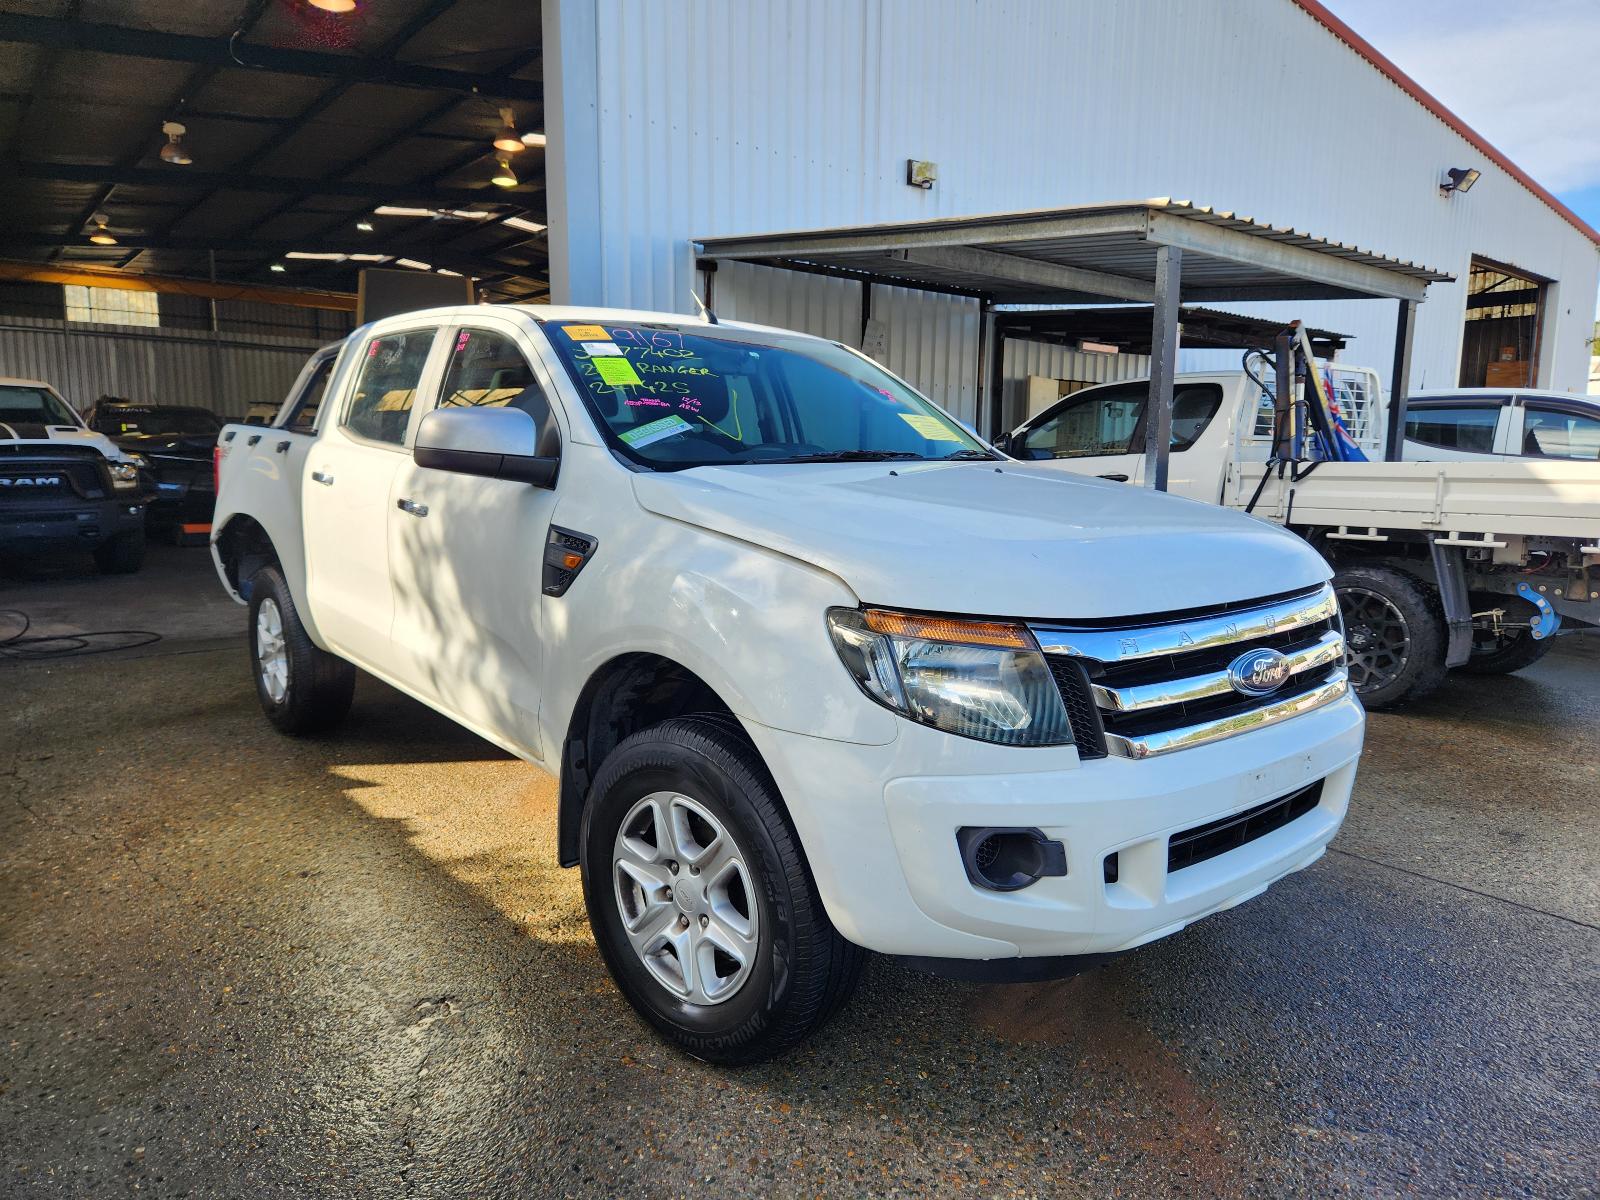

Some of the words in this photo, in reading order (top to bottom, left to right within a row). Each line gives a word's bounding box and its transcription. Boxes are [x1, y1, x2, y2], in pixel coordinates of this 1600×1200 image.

[612, 329, 684, 348] 9167
[636, 362, 719, 377] RANGER
[0, 478, 59, 486] RAM
[1252, 657, 1284, 684] Ford
